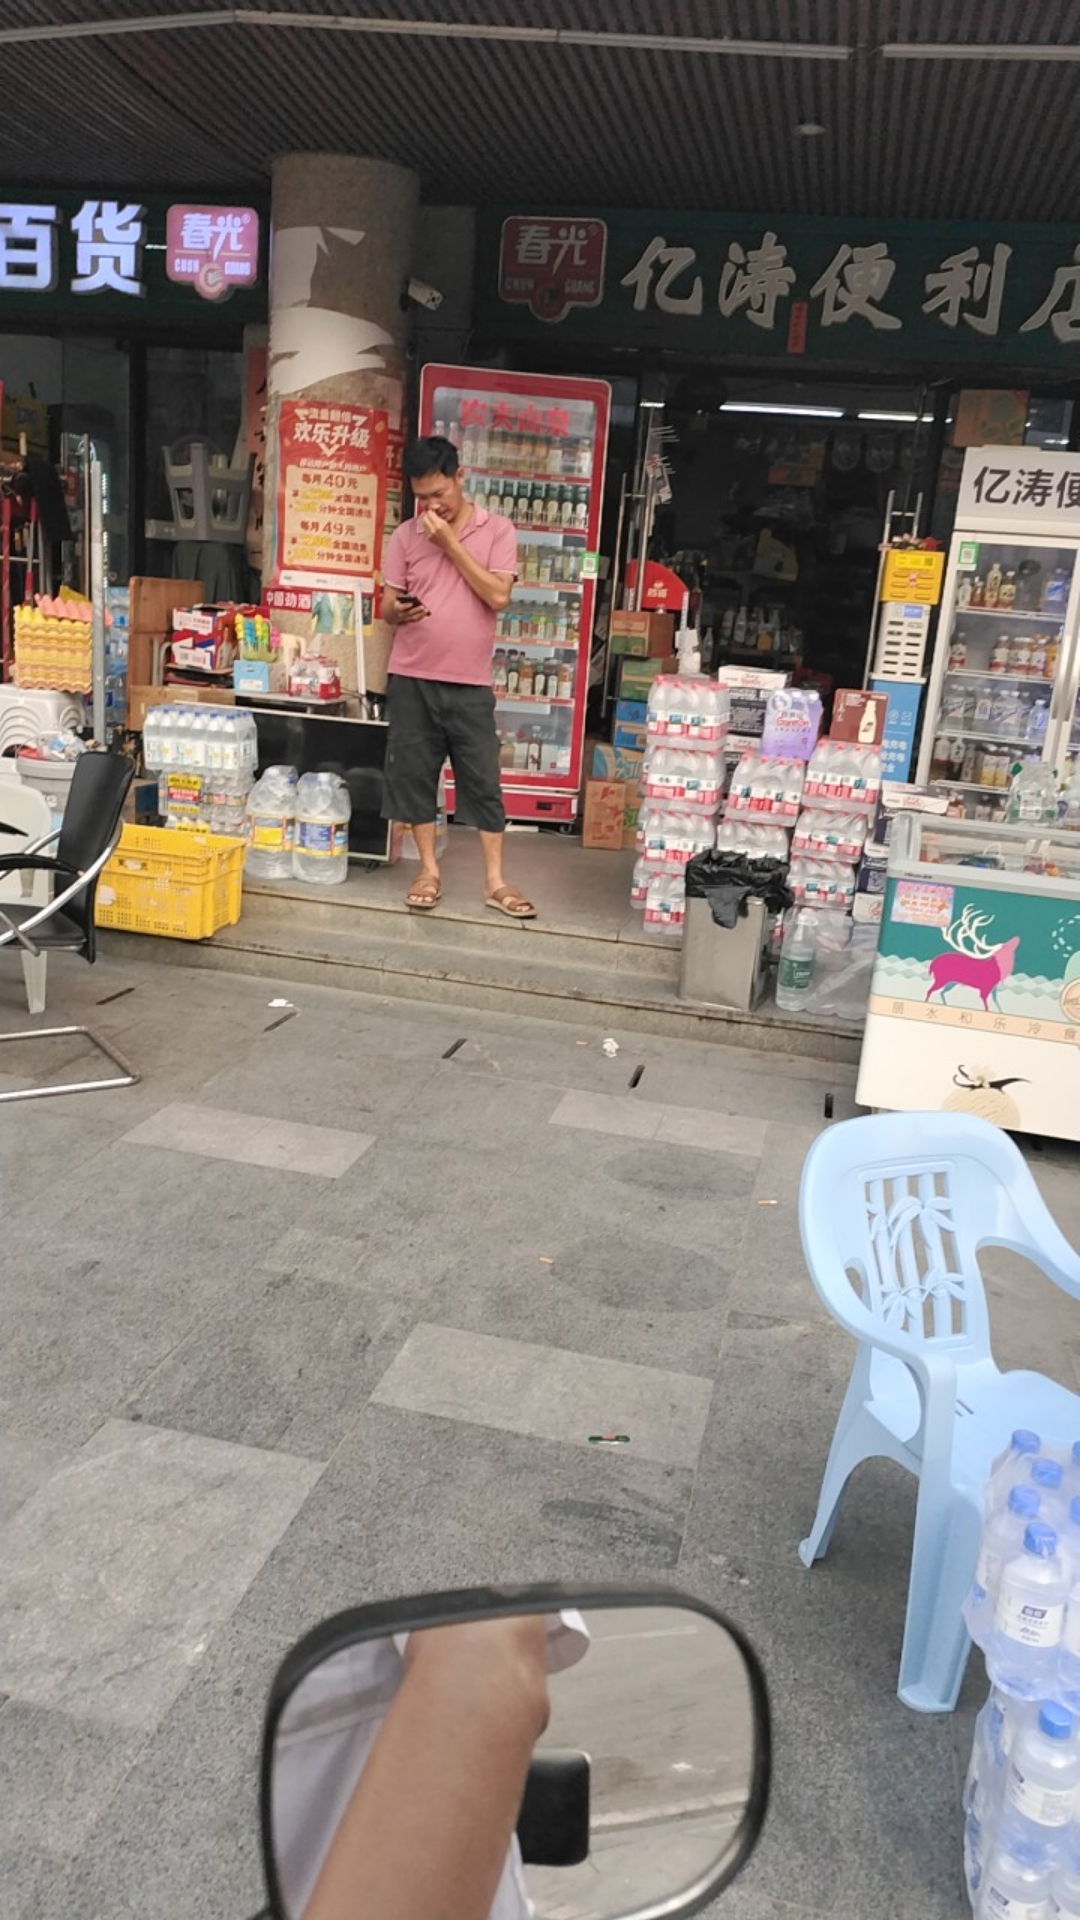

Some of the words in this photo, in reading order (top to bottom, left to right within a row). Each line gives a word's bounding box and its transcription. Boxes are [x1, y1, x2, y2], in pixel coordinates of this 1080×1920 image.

[0, 201, 141, 294] 百货
[180, 213, 244, 261] 春光
[515, 225, 589, 276] 春光
[620, 231, 1080, 343] 亿涛便利店
[293, 421, 371, 449] 欢乐升级
[460, 397, 570, 438] 农夫山泉
[302, 473, 358, 490] 每月40元
[973, 465, 1080, 509] 亿涛便
[300, 520, 356, 536] 每月49元
[266, 590, 313, 610] 中国劲酒
